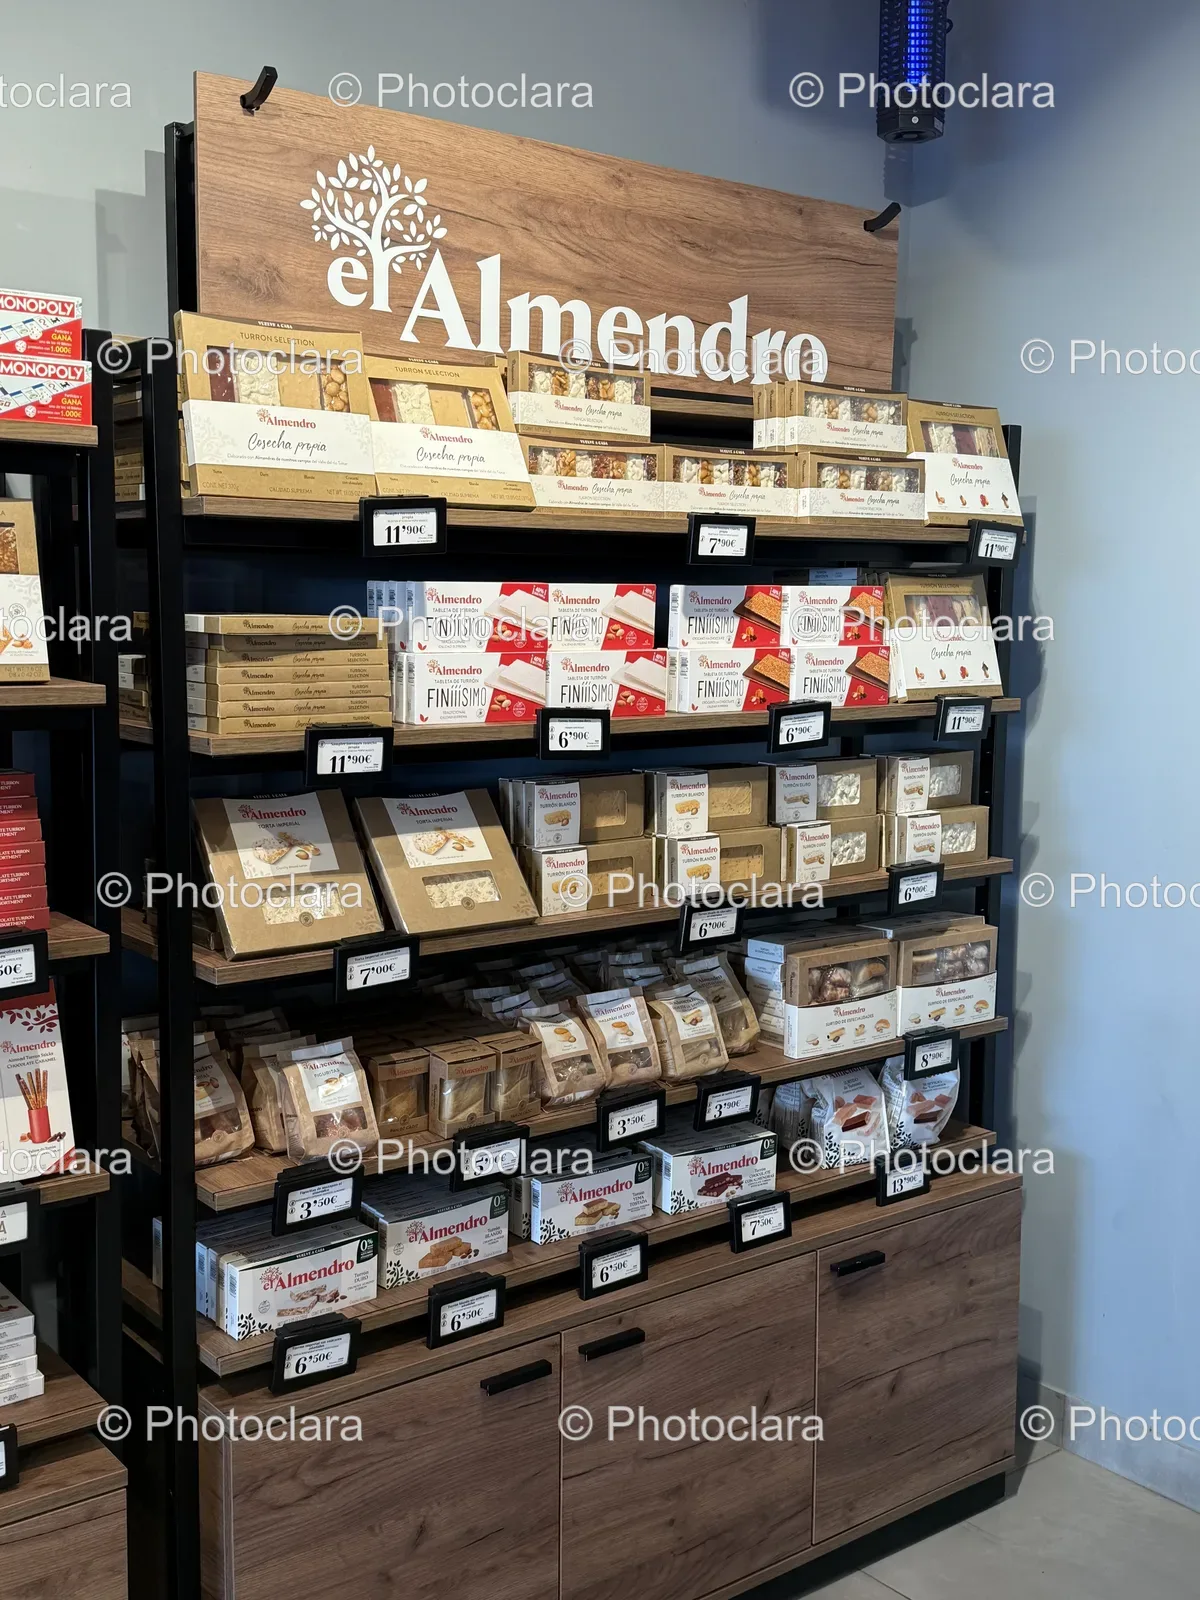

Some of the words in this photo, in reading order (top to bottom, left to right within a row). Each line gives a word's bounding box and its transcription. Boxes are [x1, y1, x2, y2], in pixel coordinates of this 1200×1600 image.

[400, 248, 829, 386] Almendro
[51, 333, 72, 342] GANA
[240, 331, 273, 343] TURRON
[273, 335, 315, 347] SELECTION
[0, 360, 83, 382] MONOPOLY
[395, 366, 424, 375] TURRON
[424, 368, 460, 378] SELECTION
[61, 398, 82, 406] GANA
[266, 414, 317, 430] Almendro
[248, 429, 293, 451] Cosecha
[294, 440, 328, 457] propia
[429, 432, 473, 444] Almendro
[416, 444, 455, 462] Cosecha
[457, 453, 486, 467] propia
[950, 471, 973, 486] Cosecha
[562, 483, 589, 492] Almendro
[434, 594, 482, 604] Almendro
[559, 596, 601, 605] Almendro
[695, 596, 732, 605] Almendro
[803, 596, 838, 605] Almendro
[930, 644, 954, 660] Cosecha
[704, 660, 741, 669] Almendro
[810, 657, 845, 666] Almendro
[435, 665, 482, 676] Almendro
[568, 663, 610, 673] Almendro
[905, 765, 929, 774] Almendro
[784, 772, 815, 781] Almendro
[675, 782, 707, 791] Almendro
[544, 791, 578, 801] Almendro
[250, 807, 307, 821] Almendro
[408, 805, 458, 817] Almendro
[914, 821, 940, 831] Almendro
[804, 833, 830, 841] Almendro
[686, 846, 718, 855] Almendro
[551, 859, 585, 869] Almendro
[939, 987, 966, 998] Almendro
[600, 1003, 632, 1017] Almendro
[839, 1006, 866, 1017] Almendro
[9, 1039, 57, 1055] Almendro
[8, 1054, 25, 1063] Almond
[6, 1060, 34, 1069] CHOCOLATE
[460, 1065, 489, 1075] Almendro
[698, 1154, 759, 1178] Almendro
[568, 1179, 633, 1205] Almendro
[418, 1214, 488, 1245] Almendro
[274, 1258, 355, 1292] Almendro
